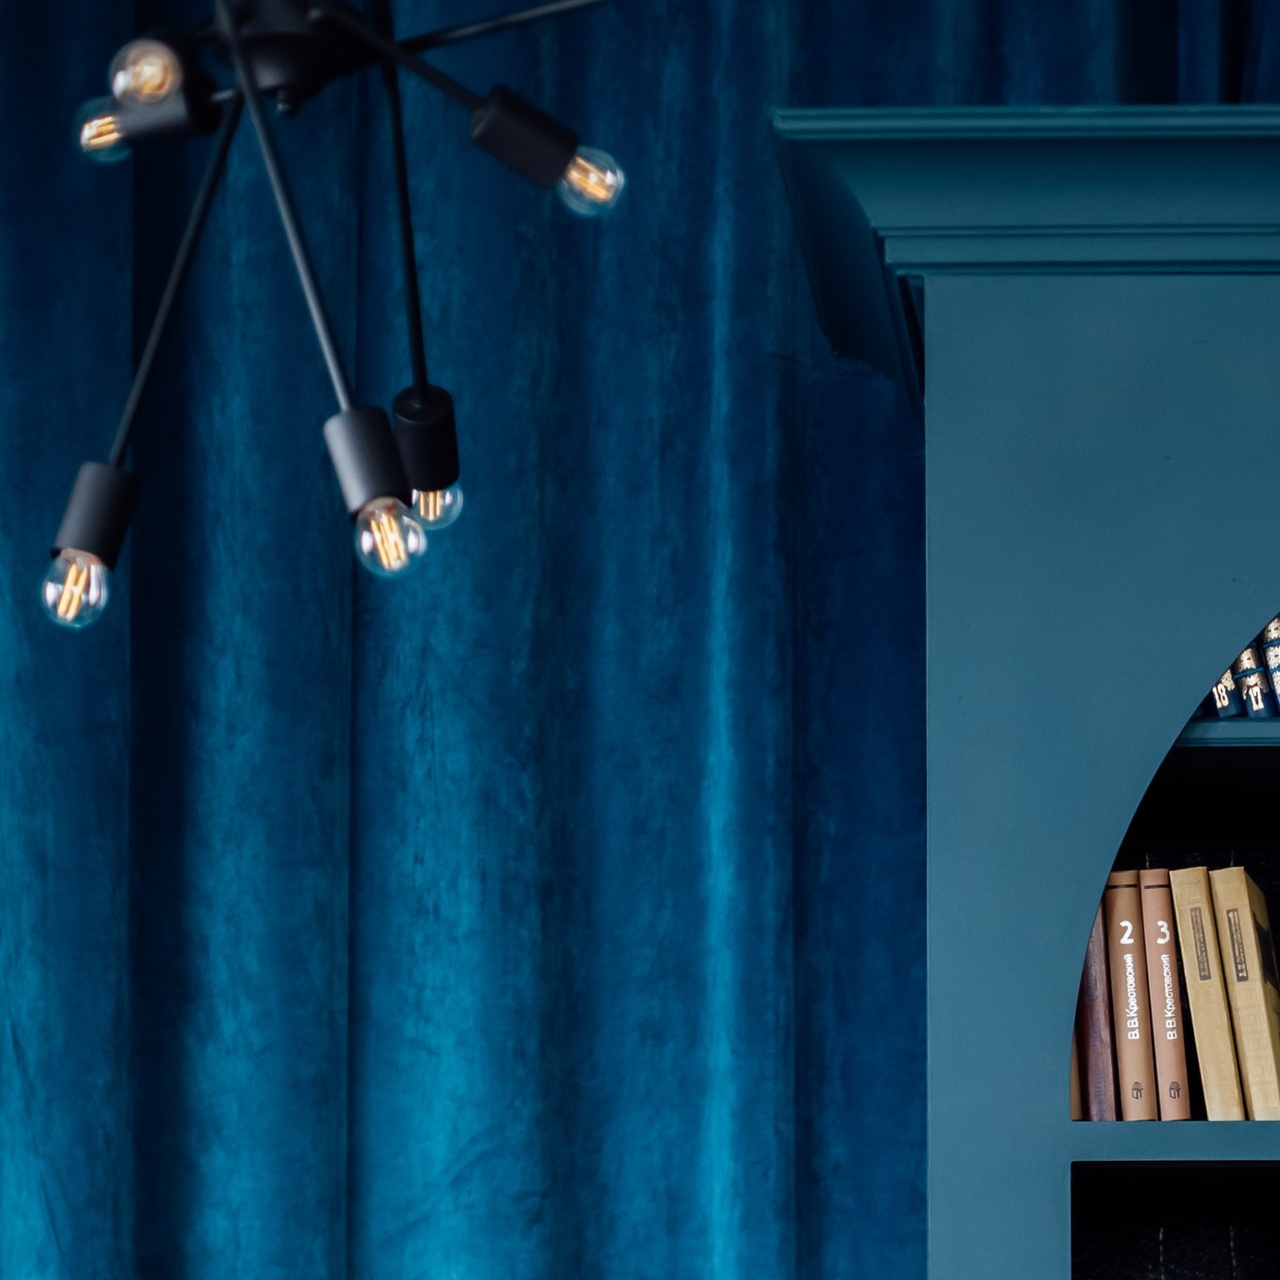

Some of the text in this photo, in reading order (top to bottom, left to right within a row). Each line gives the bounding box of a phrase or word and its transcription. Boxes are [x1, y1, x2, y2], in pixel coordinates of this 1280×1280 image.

[1213, 683, 1229, 709] 18
[1250, 685, 1264, 711] 17
[1119, 920, 1134, 944] 2
[1156, 920, 1170, 944] 3
